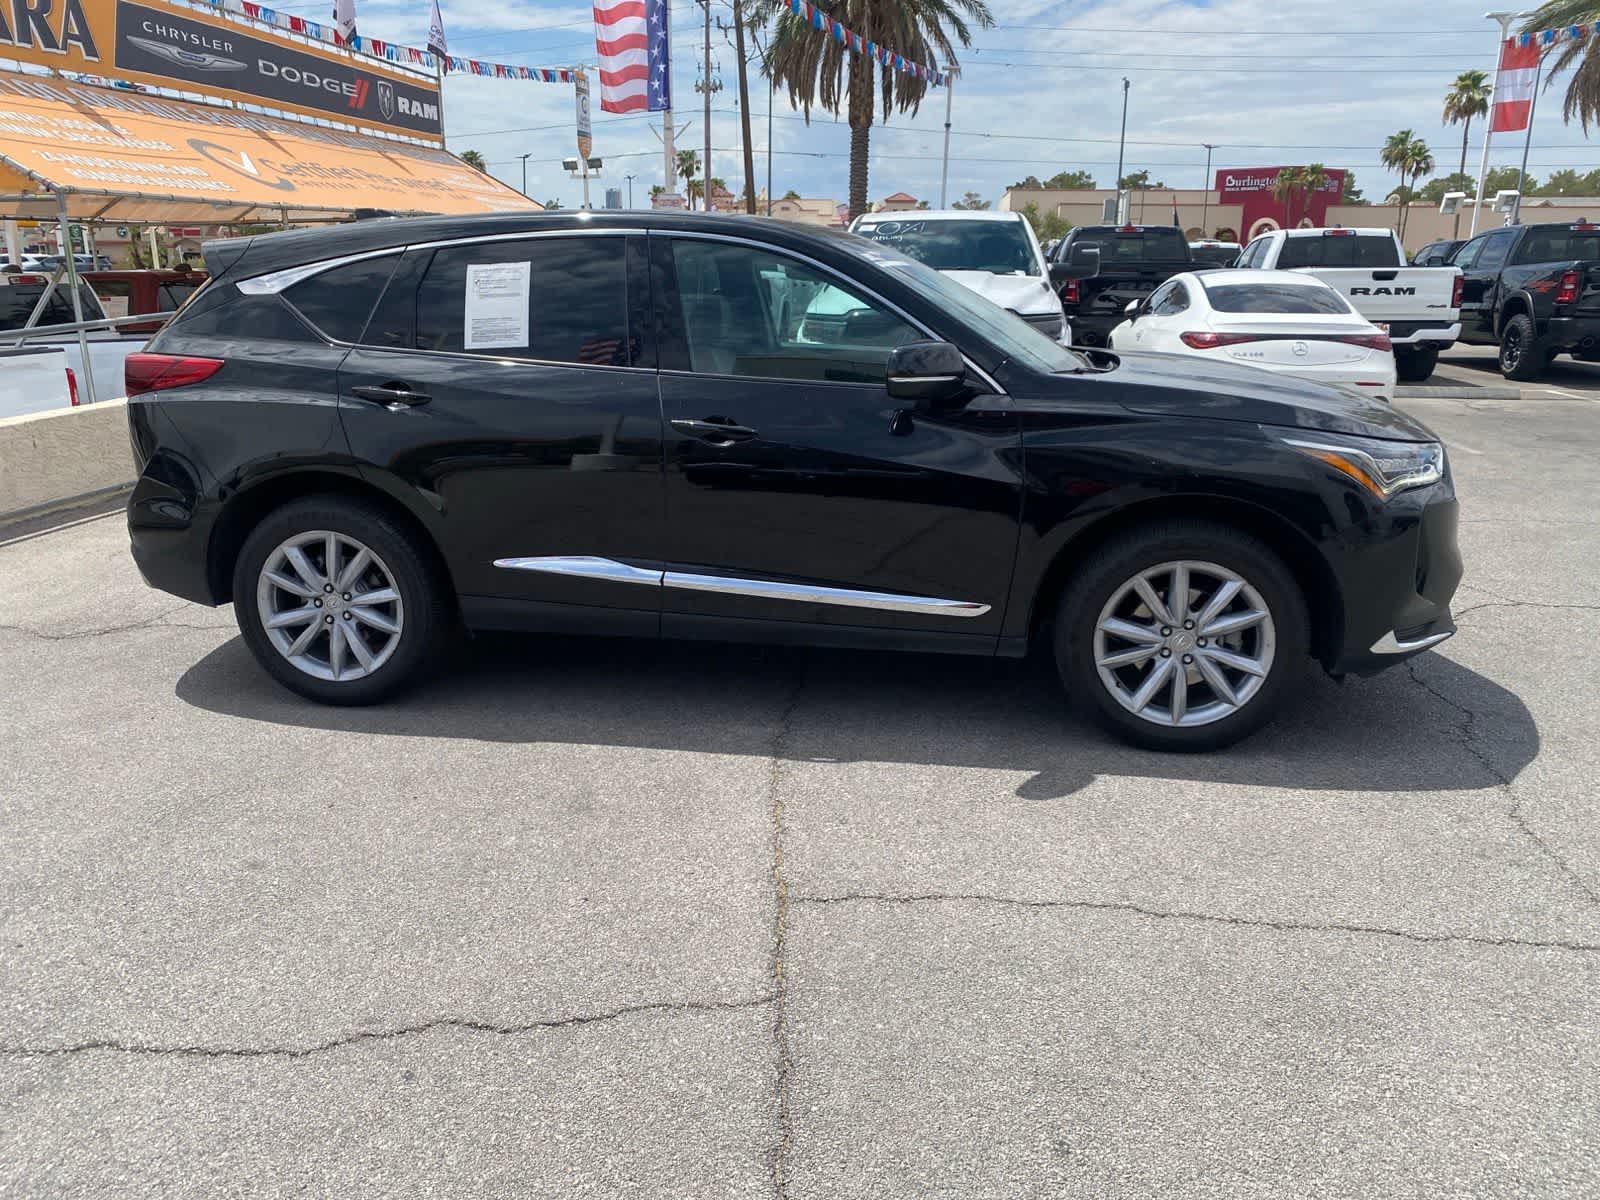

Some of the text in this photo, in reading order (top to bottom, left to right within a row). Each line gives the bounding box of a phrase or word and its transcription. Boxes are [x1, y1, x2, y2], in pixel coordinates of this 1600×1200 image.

[0, 0, 101, 62] RA
[142, 21, 233, 53] CHRYSLER
[258, 59, 359, 97] DODGE
[397, 96, 438, 121] RAM
[1350, 287, 1416, 296] RAM
